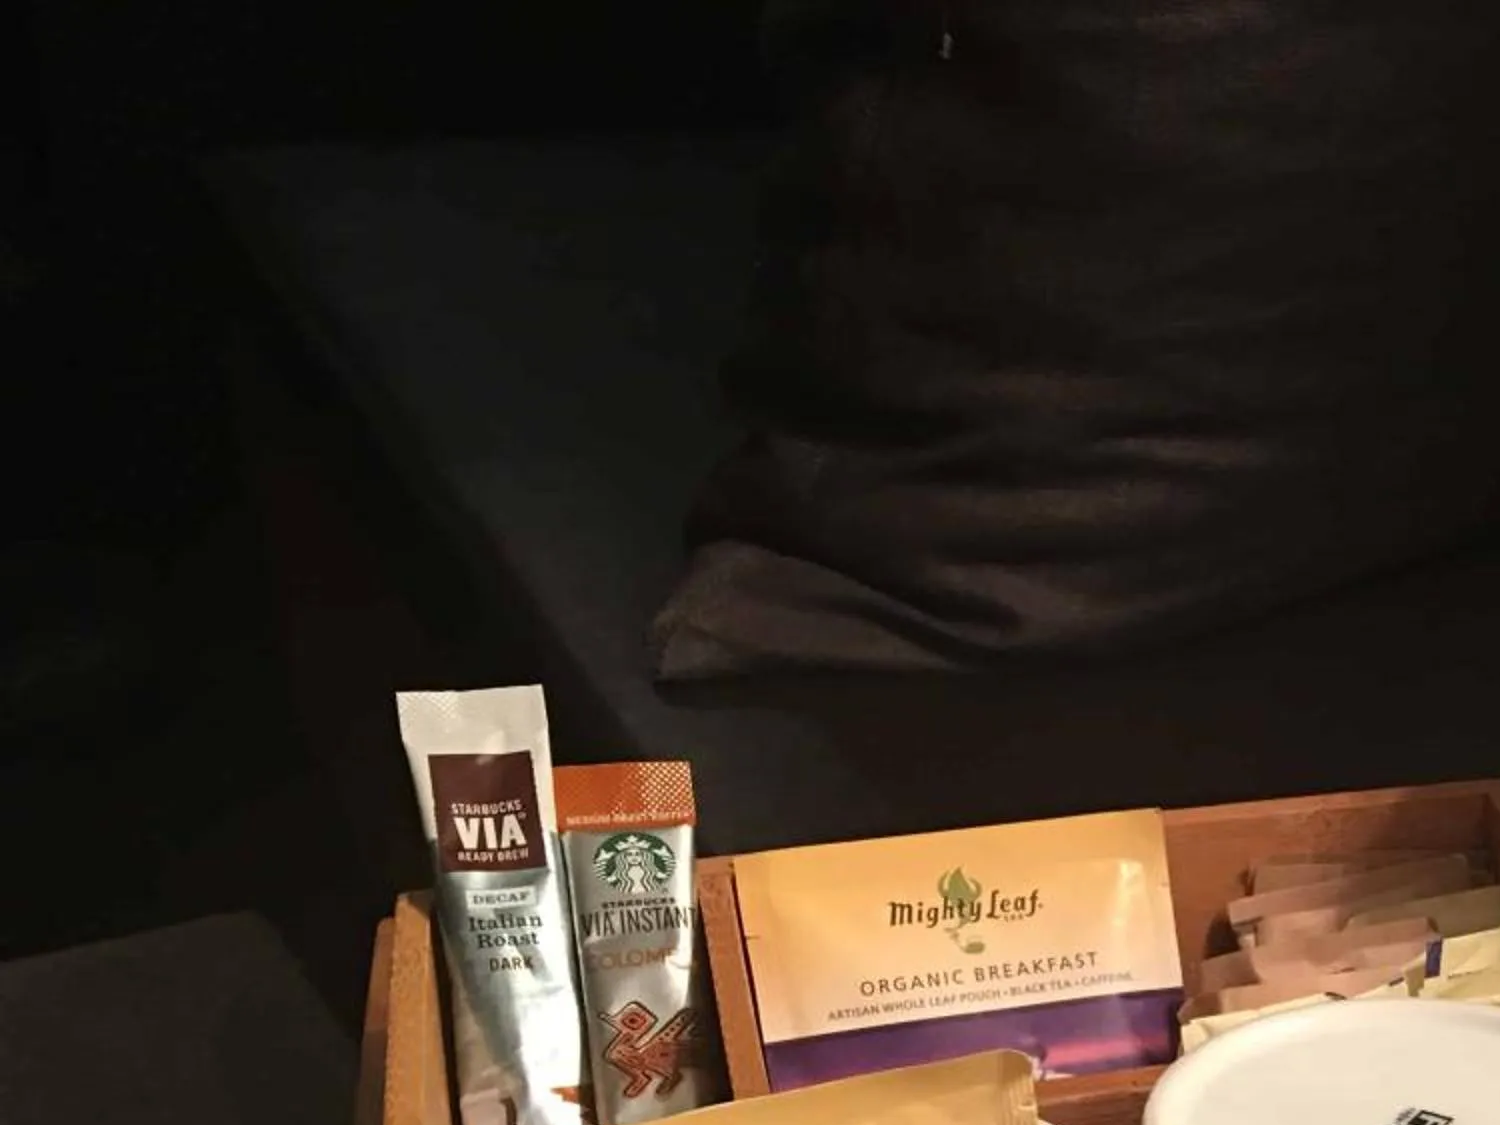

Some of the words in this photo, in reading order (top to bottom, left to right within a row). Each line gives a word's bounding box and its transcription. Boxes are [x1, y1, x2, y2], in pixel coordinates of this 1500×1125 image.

[451, 799, 522, 815] STARBUCKS
[453, 814, 527, 850] VIA
[457, 851, 495, 862] READY
[497, 848, 529, 861] BREW
[472, 891, 530, 905] DECAF
[601, 897, 676, 909] STARBUCKS
[888, 895, 982, 928] Mighty
[986, 889, 1038, 919] Leaf
[468, 913, 543, 932] Italian
[581, 911, 615, 937] VIA
[477, 932, 540, 949] Roast
[489, 956, 534, 972] DARK
[860, 968, 965, 997] ORGANIC
[974, 951, 1098, 983] BREAKFAST
[828, 1004, 880, 1020] ARTISAN
[881, 998, 927, 1013] WHOLE
[929, 994, 956, 1007] LEAF
[960, 989, 1001, 1004] POUCH
[1009, 984, 1046, 997] BLACK
[1050, 980, 1073, 992] TEA
